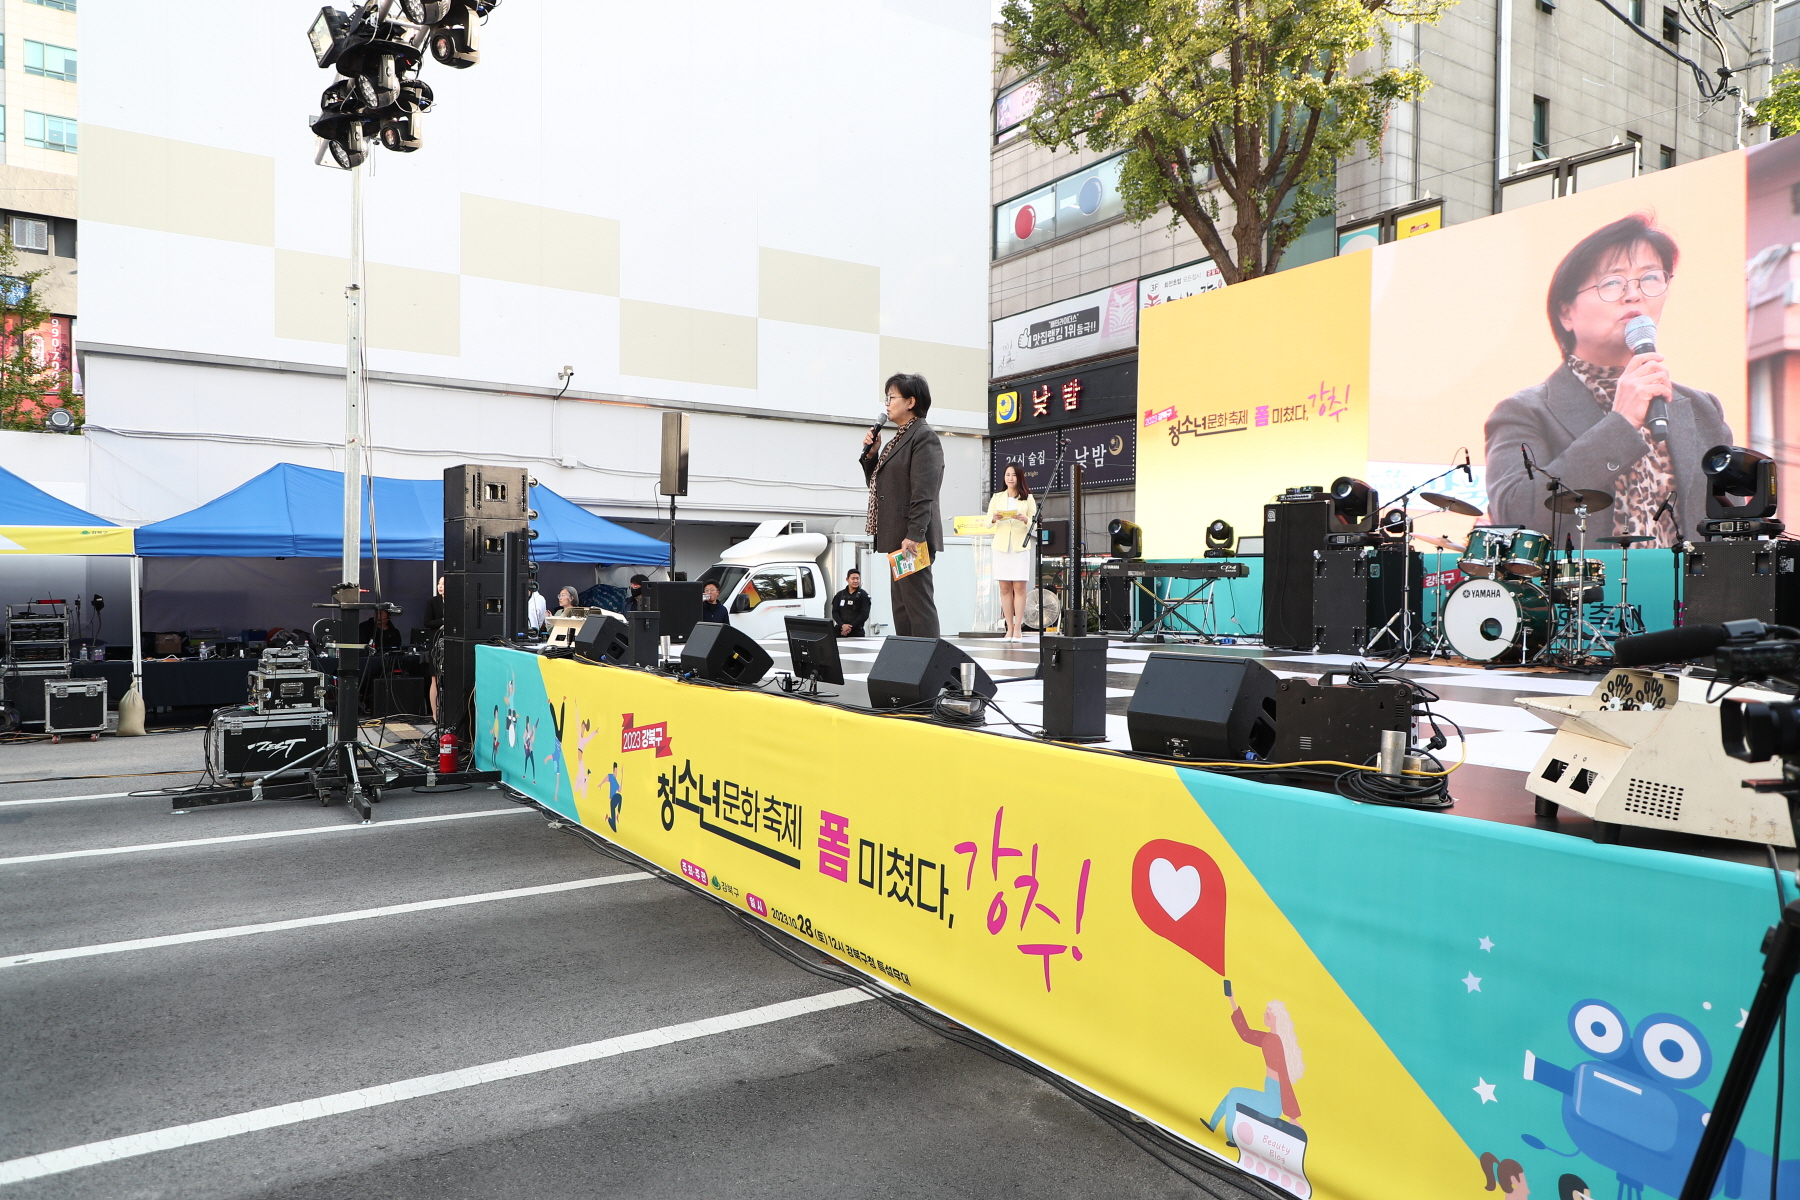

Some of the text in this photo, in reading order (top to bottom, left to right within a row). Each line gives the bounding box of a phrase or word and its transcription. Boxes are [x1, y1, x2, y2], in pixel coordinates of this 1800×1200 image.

[1150, 283, 1159, 292] 3F
[1254, 405, 1269, 427] 폼
[1028, 450, 1045, 466] 술집
[1471, 589, 1501, 598] YAMAHA
[623, 727, 663, 749] 2023 강북구
[818, 810, 850, 883] 폼
[858, 838, 954, 930] 미쳤다,
[721, 881, 740, 898] 강북구
[953, 805, 1091, 993] 강추!
[845, 944, 877, 969] 강북구청
[877, 960, 911, 986] 특설무대
[1262, 1134, 1291, 1156] Beauty
[1269, 1149, 1286, 1165] Blog
